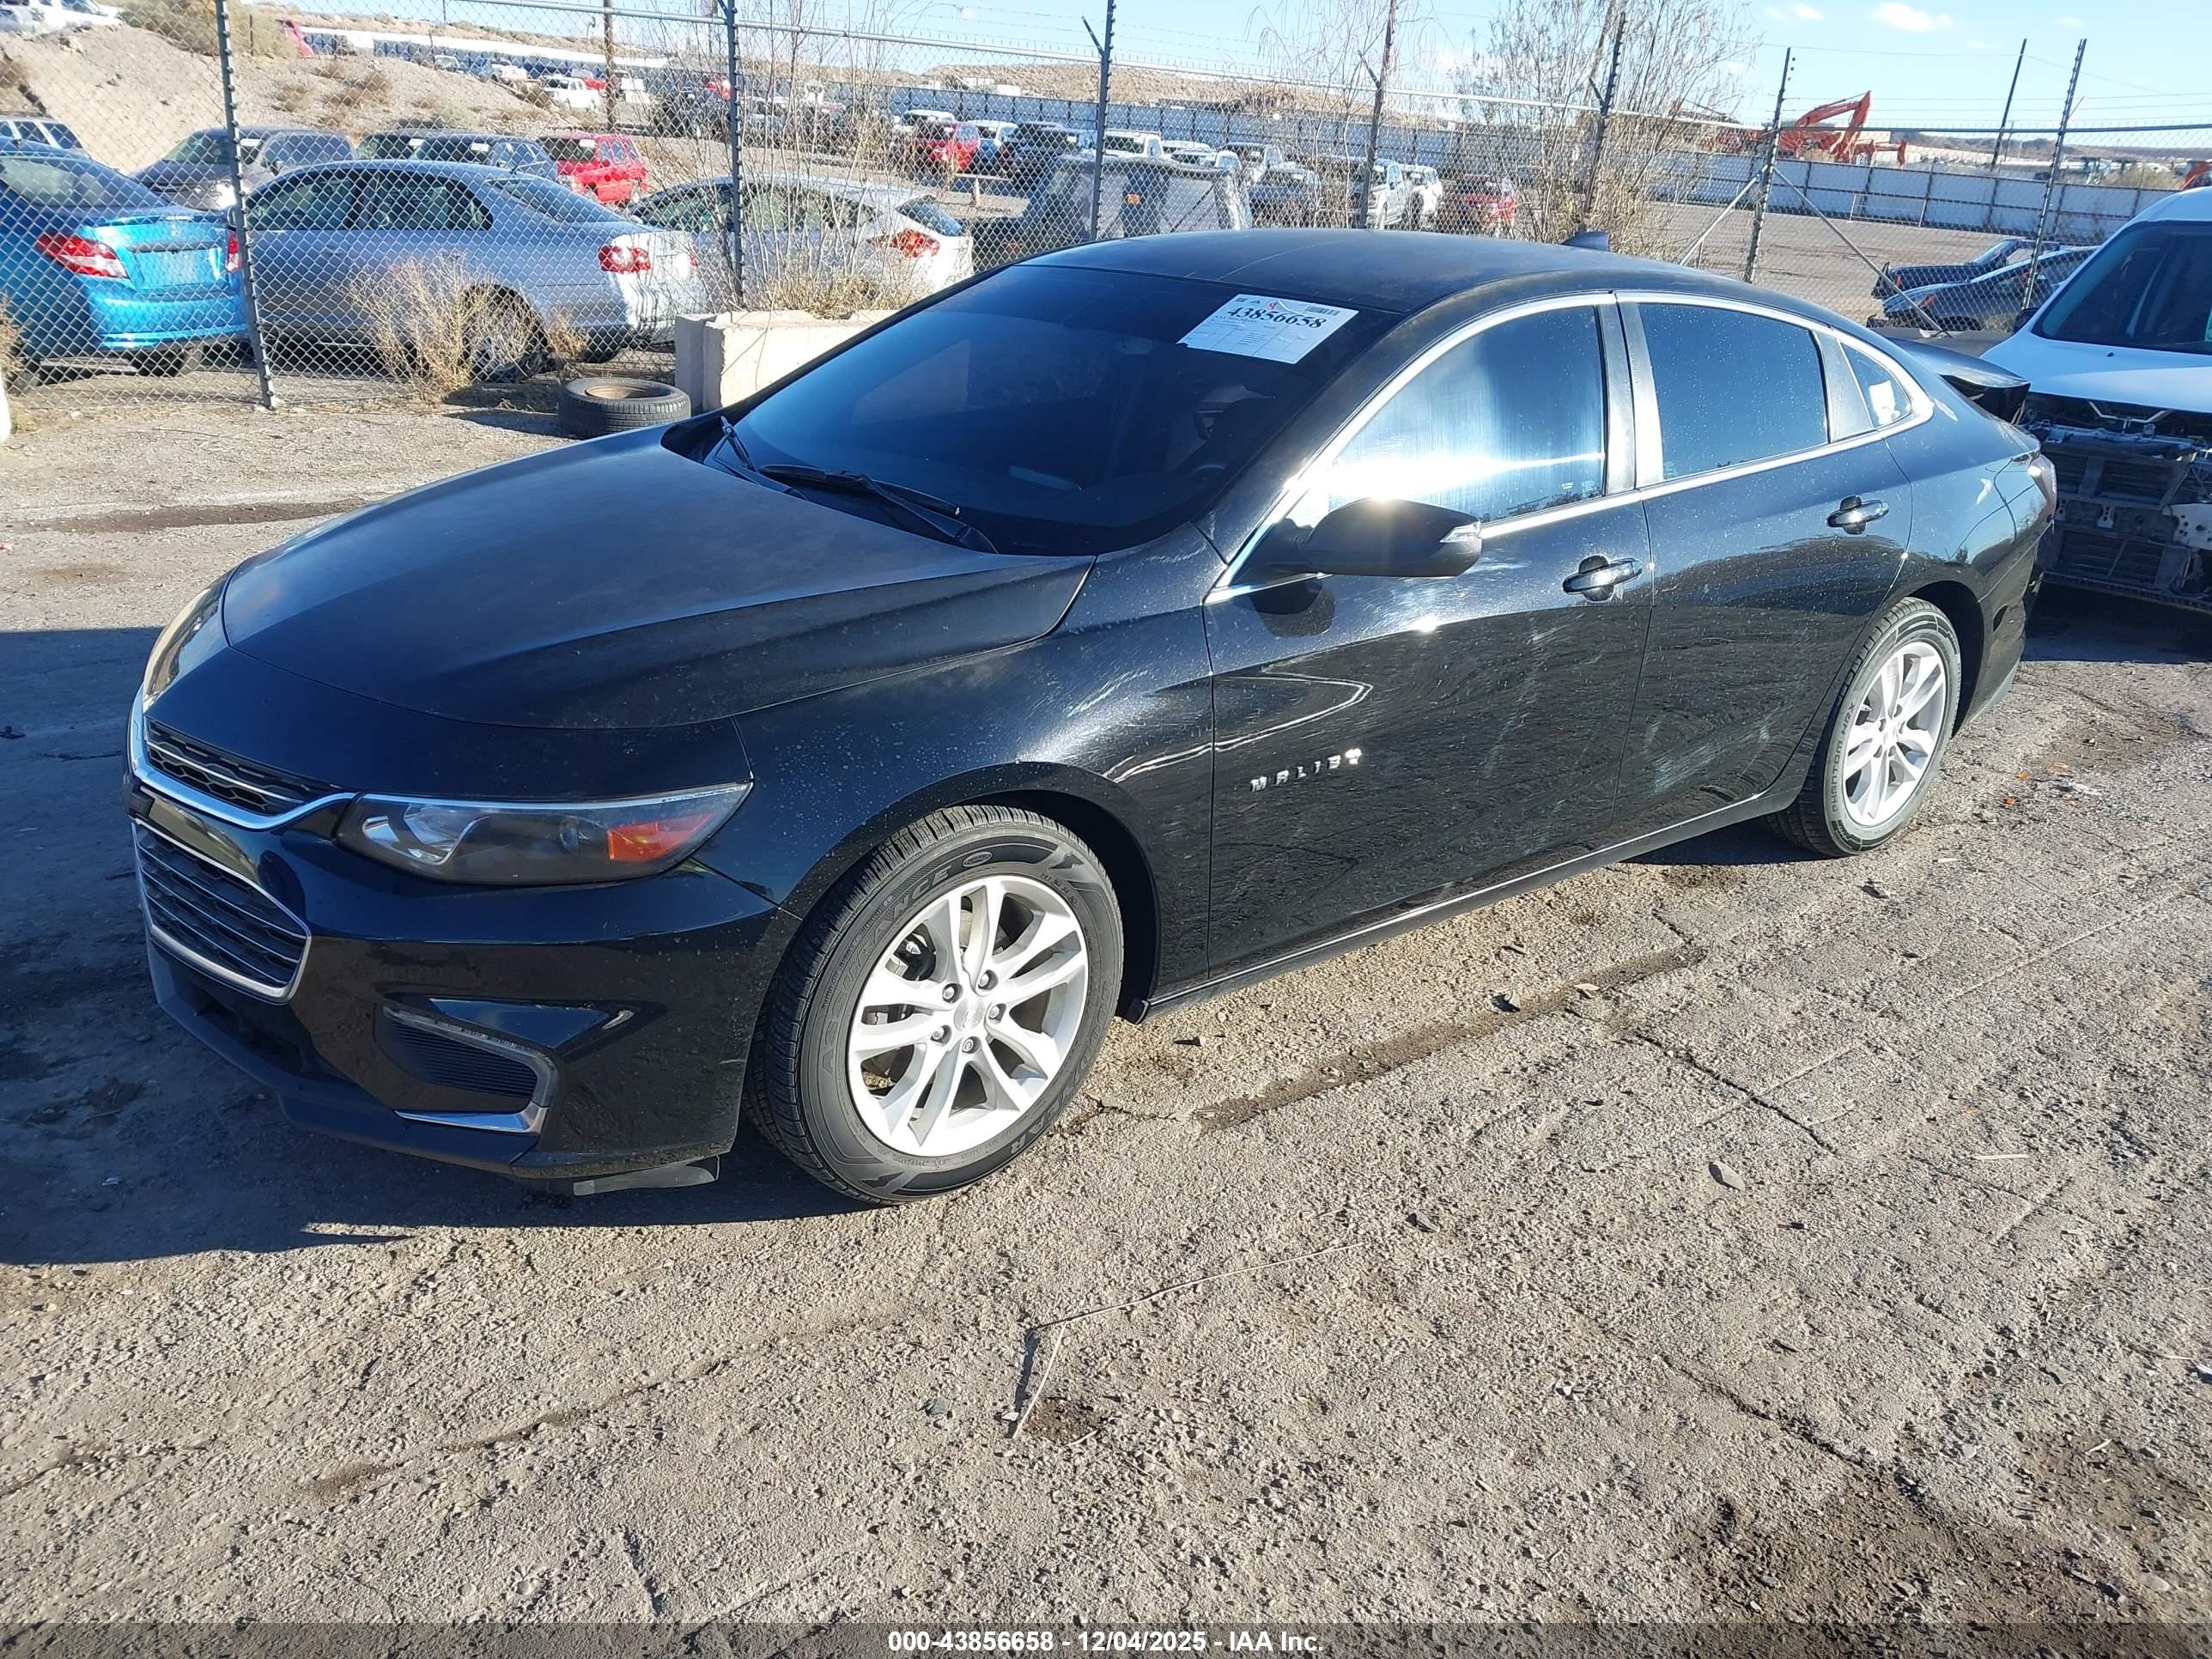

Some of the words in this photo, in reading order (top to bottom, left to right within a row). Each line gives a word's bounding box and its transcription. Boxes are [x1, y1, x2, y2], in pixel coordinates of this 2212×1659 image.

[1227, 306, 1327, 329] 43856658
[1830, 740, 1844, 812] PHANTOM
[822, 864, 951, 1074] ASSURANCE
